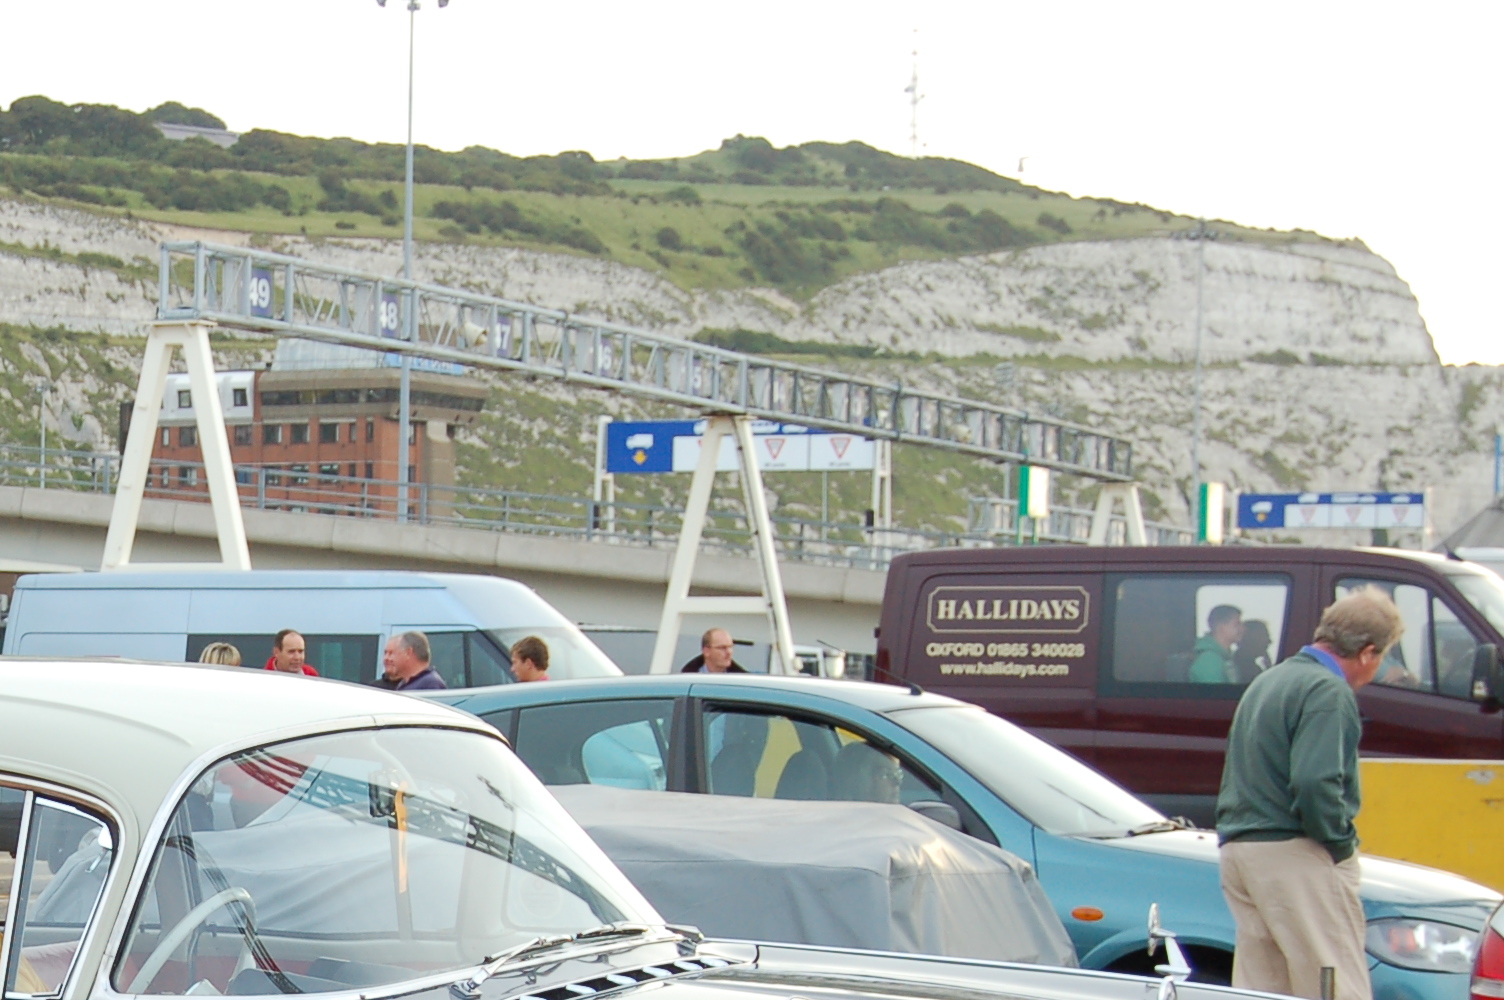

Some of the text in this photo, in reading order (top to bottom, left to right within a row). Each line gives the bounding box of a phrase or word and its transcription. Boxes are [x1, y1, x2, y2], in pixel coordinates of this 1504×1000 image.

[249, 277, 270, 308] 49
[937, 599, 1080, 620] HALLIDAYS
[926, 642, 1085, 657] OXFORD 01865 340028
[940, 661, 1069, 679] www.hallidays.com
